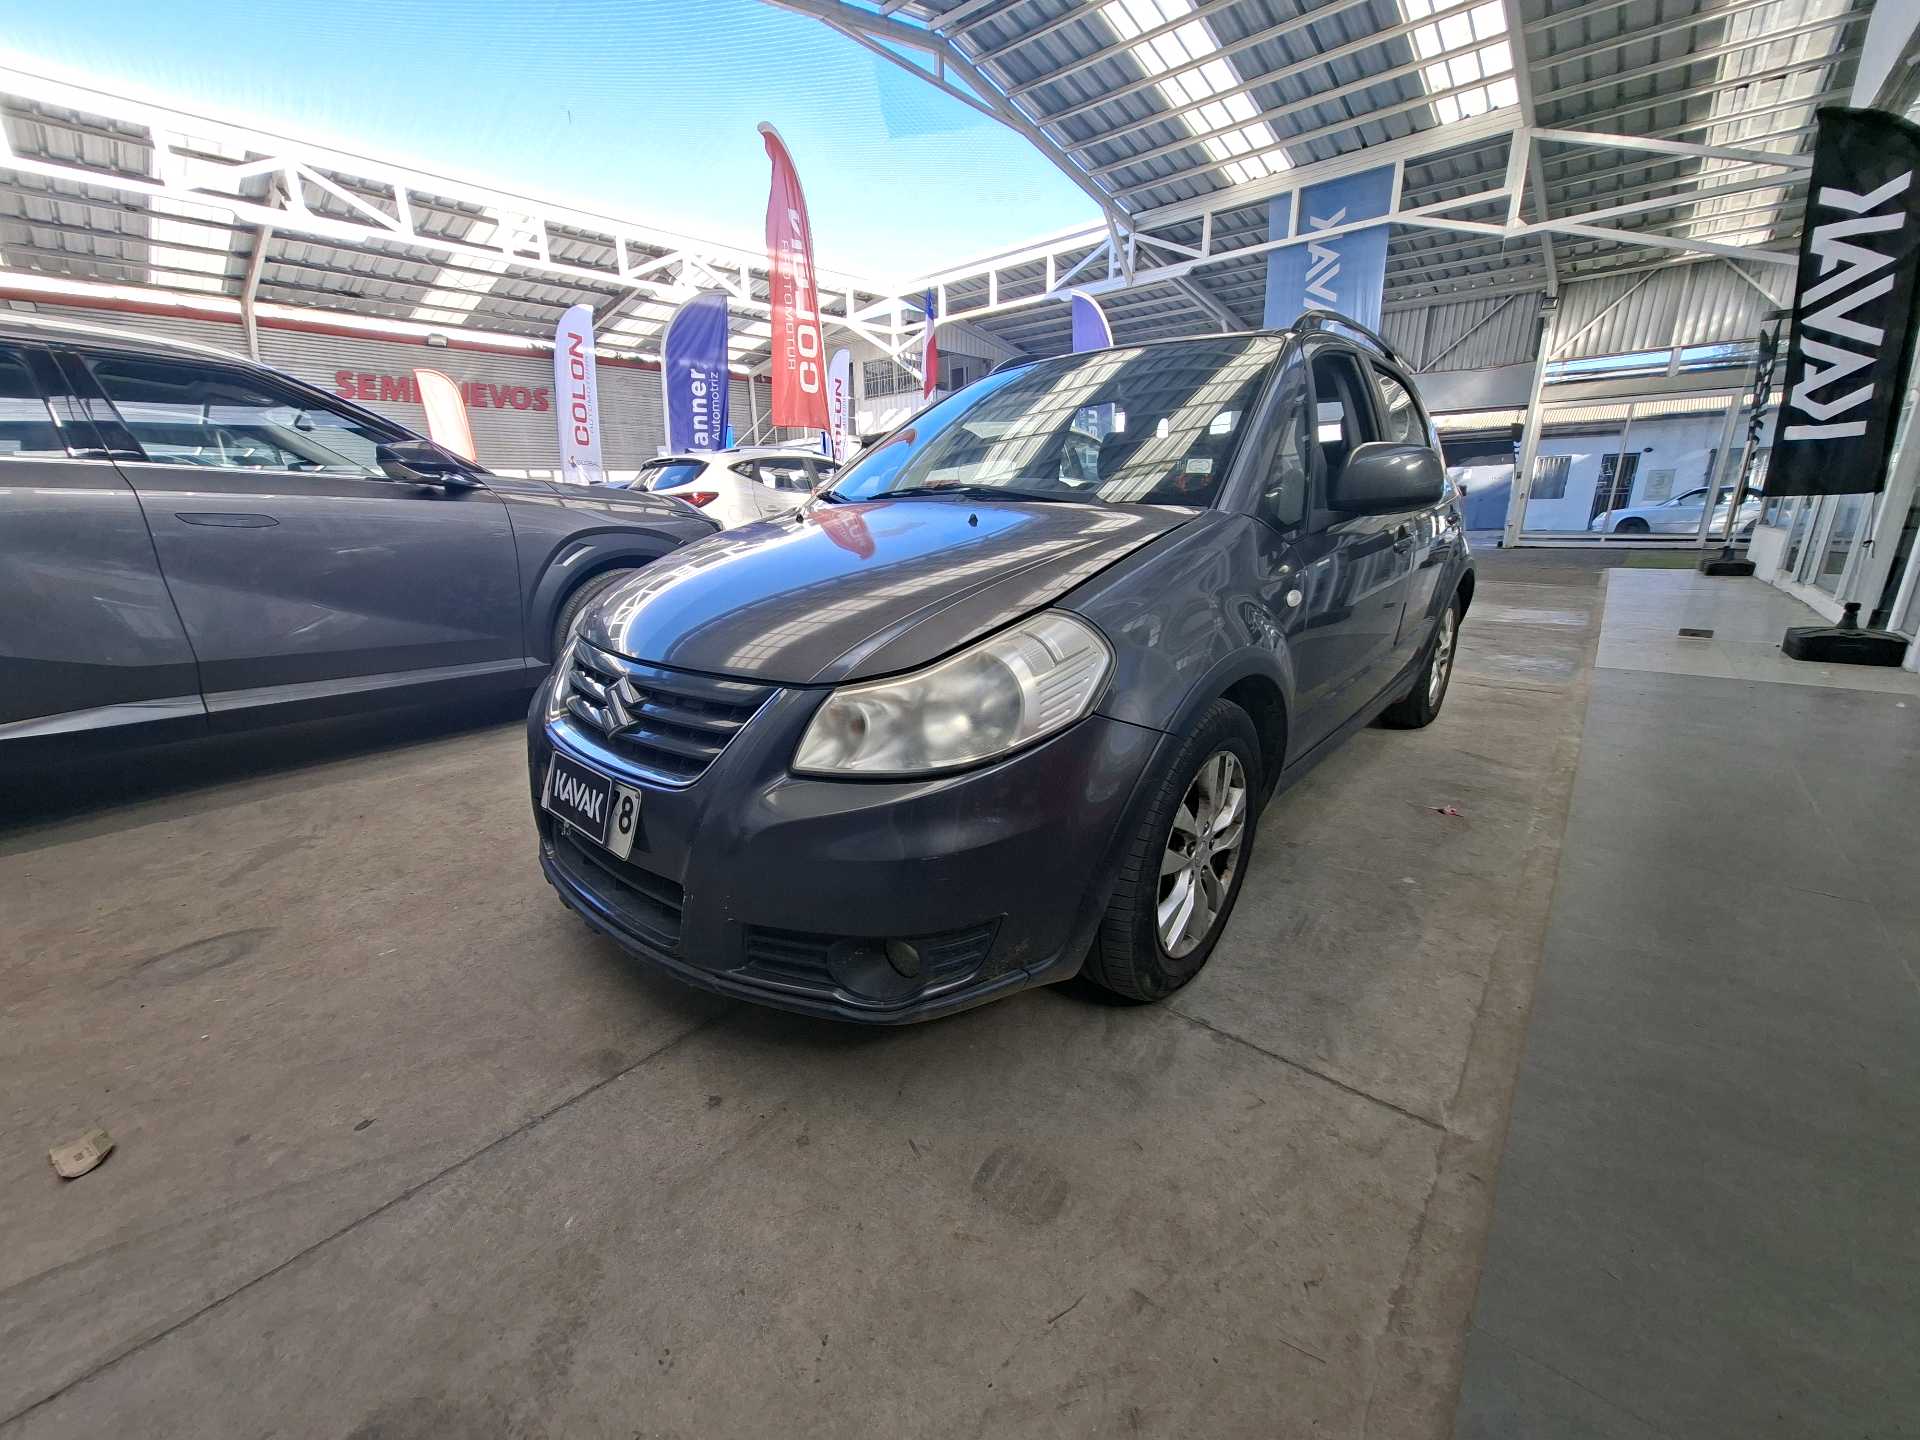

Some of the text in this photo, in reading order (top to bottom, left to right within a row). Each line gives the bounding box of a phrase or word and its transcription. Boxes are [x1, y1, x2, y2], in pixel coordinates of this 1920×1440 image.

[335, 370, 549, 411] SEMIEVOS
[567, 332, 590, 446] COLON
[690, 368, 709, 446] anner
[709, 371, 721, 441] Automotriz
[553, 768, 604, 824] KAVAK
